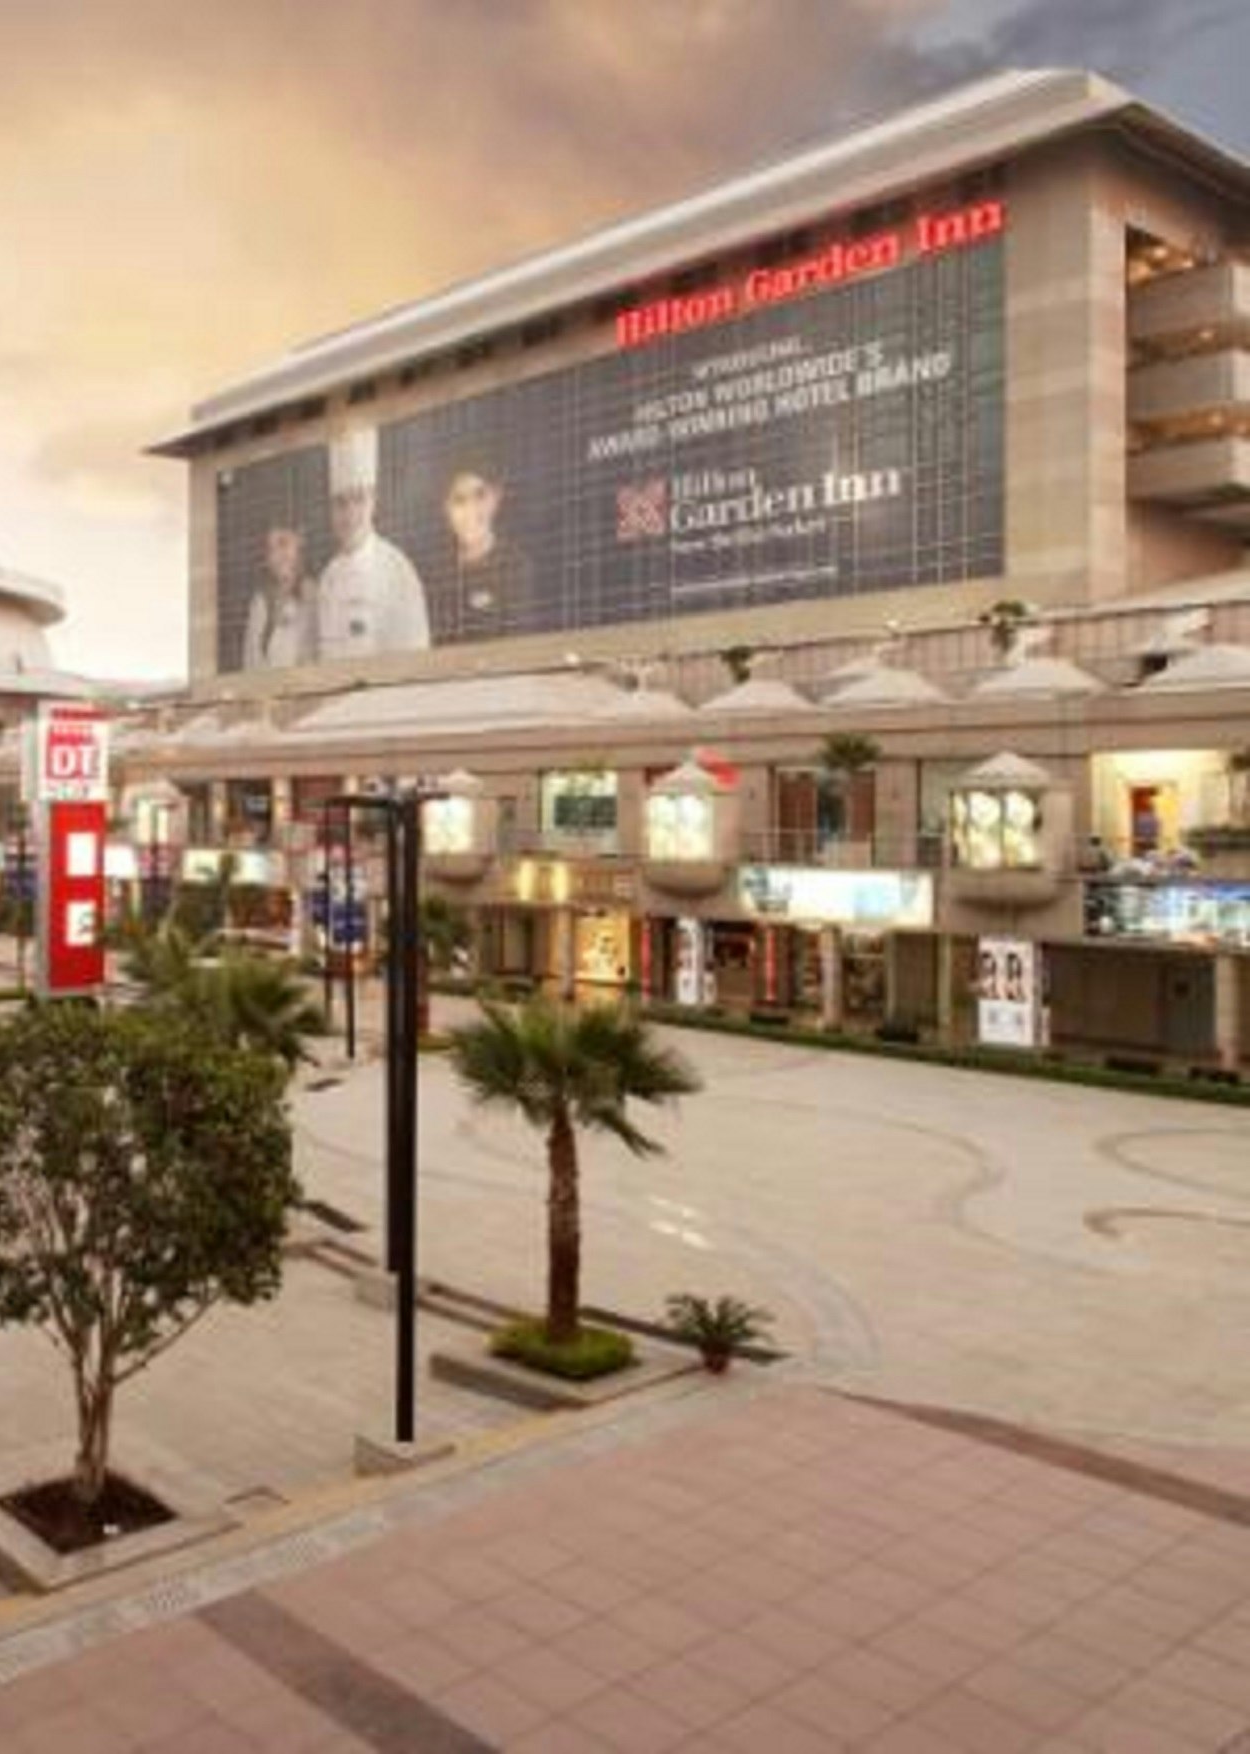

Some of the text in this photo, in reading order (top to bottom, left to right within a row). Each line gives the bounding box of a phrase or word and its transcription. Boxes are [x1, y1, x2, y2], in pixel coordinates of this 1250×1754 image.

[616, 200, 1003, 347] Hilton Garden Inn
[52, 745, 98, 776] DT
